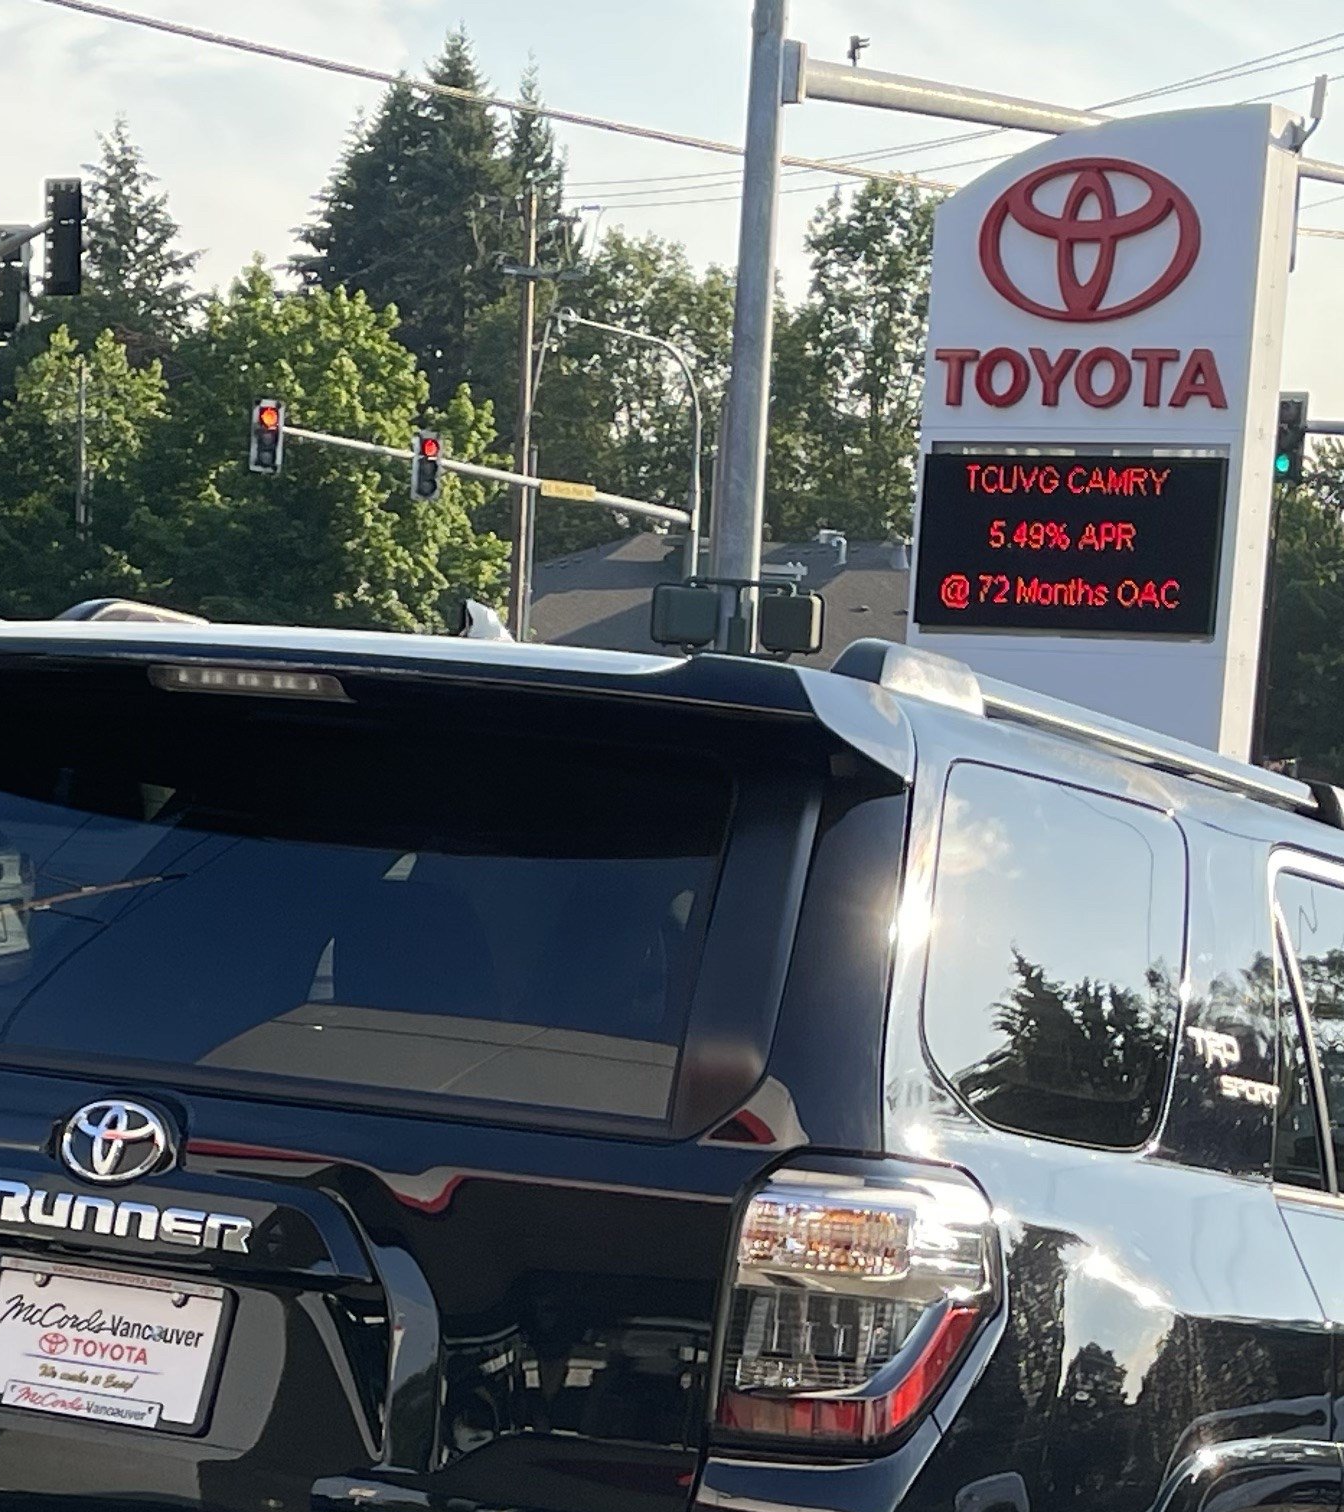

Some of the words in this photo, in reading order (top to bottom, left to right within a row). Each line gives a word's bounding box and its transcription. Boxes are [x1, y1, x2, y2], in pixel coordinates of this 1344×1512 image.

[934, 346, 1229, 410] TOYOTA
[1066, 463, 1172, 498] CAMRY
[987, 519, 1071, 552] 5.49%
[1077, 521, 1138, 553] APR
[977, 573, 1011, 605] 72
[1014, 575, 1110, 608] Months
[1116, 577, 1181, 610] OAC
[1186, 1025, 1241, 1069] TRD
[1218, 1073, 1281, 1109] SPORT
[109, 1314, 205, 1349] Vancouver
[72, 1337, 149, 1366] TOYOTA
